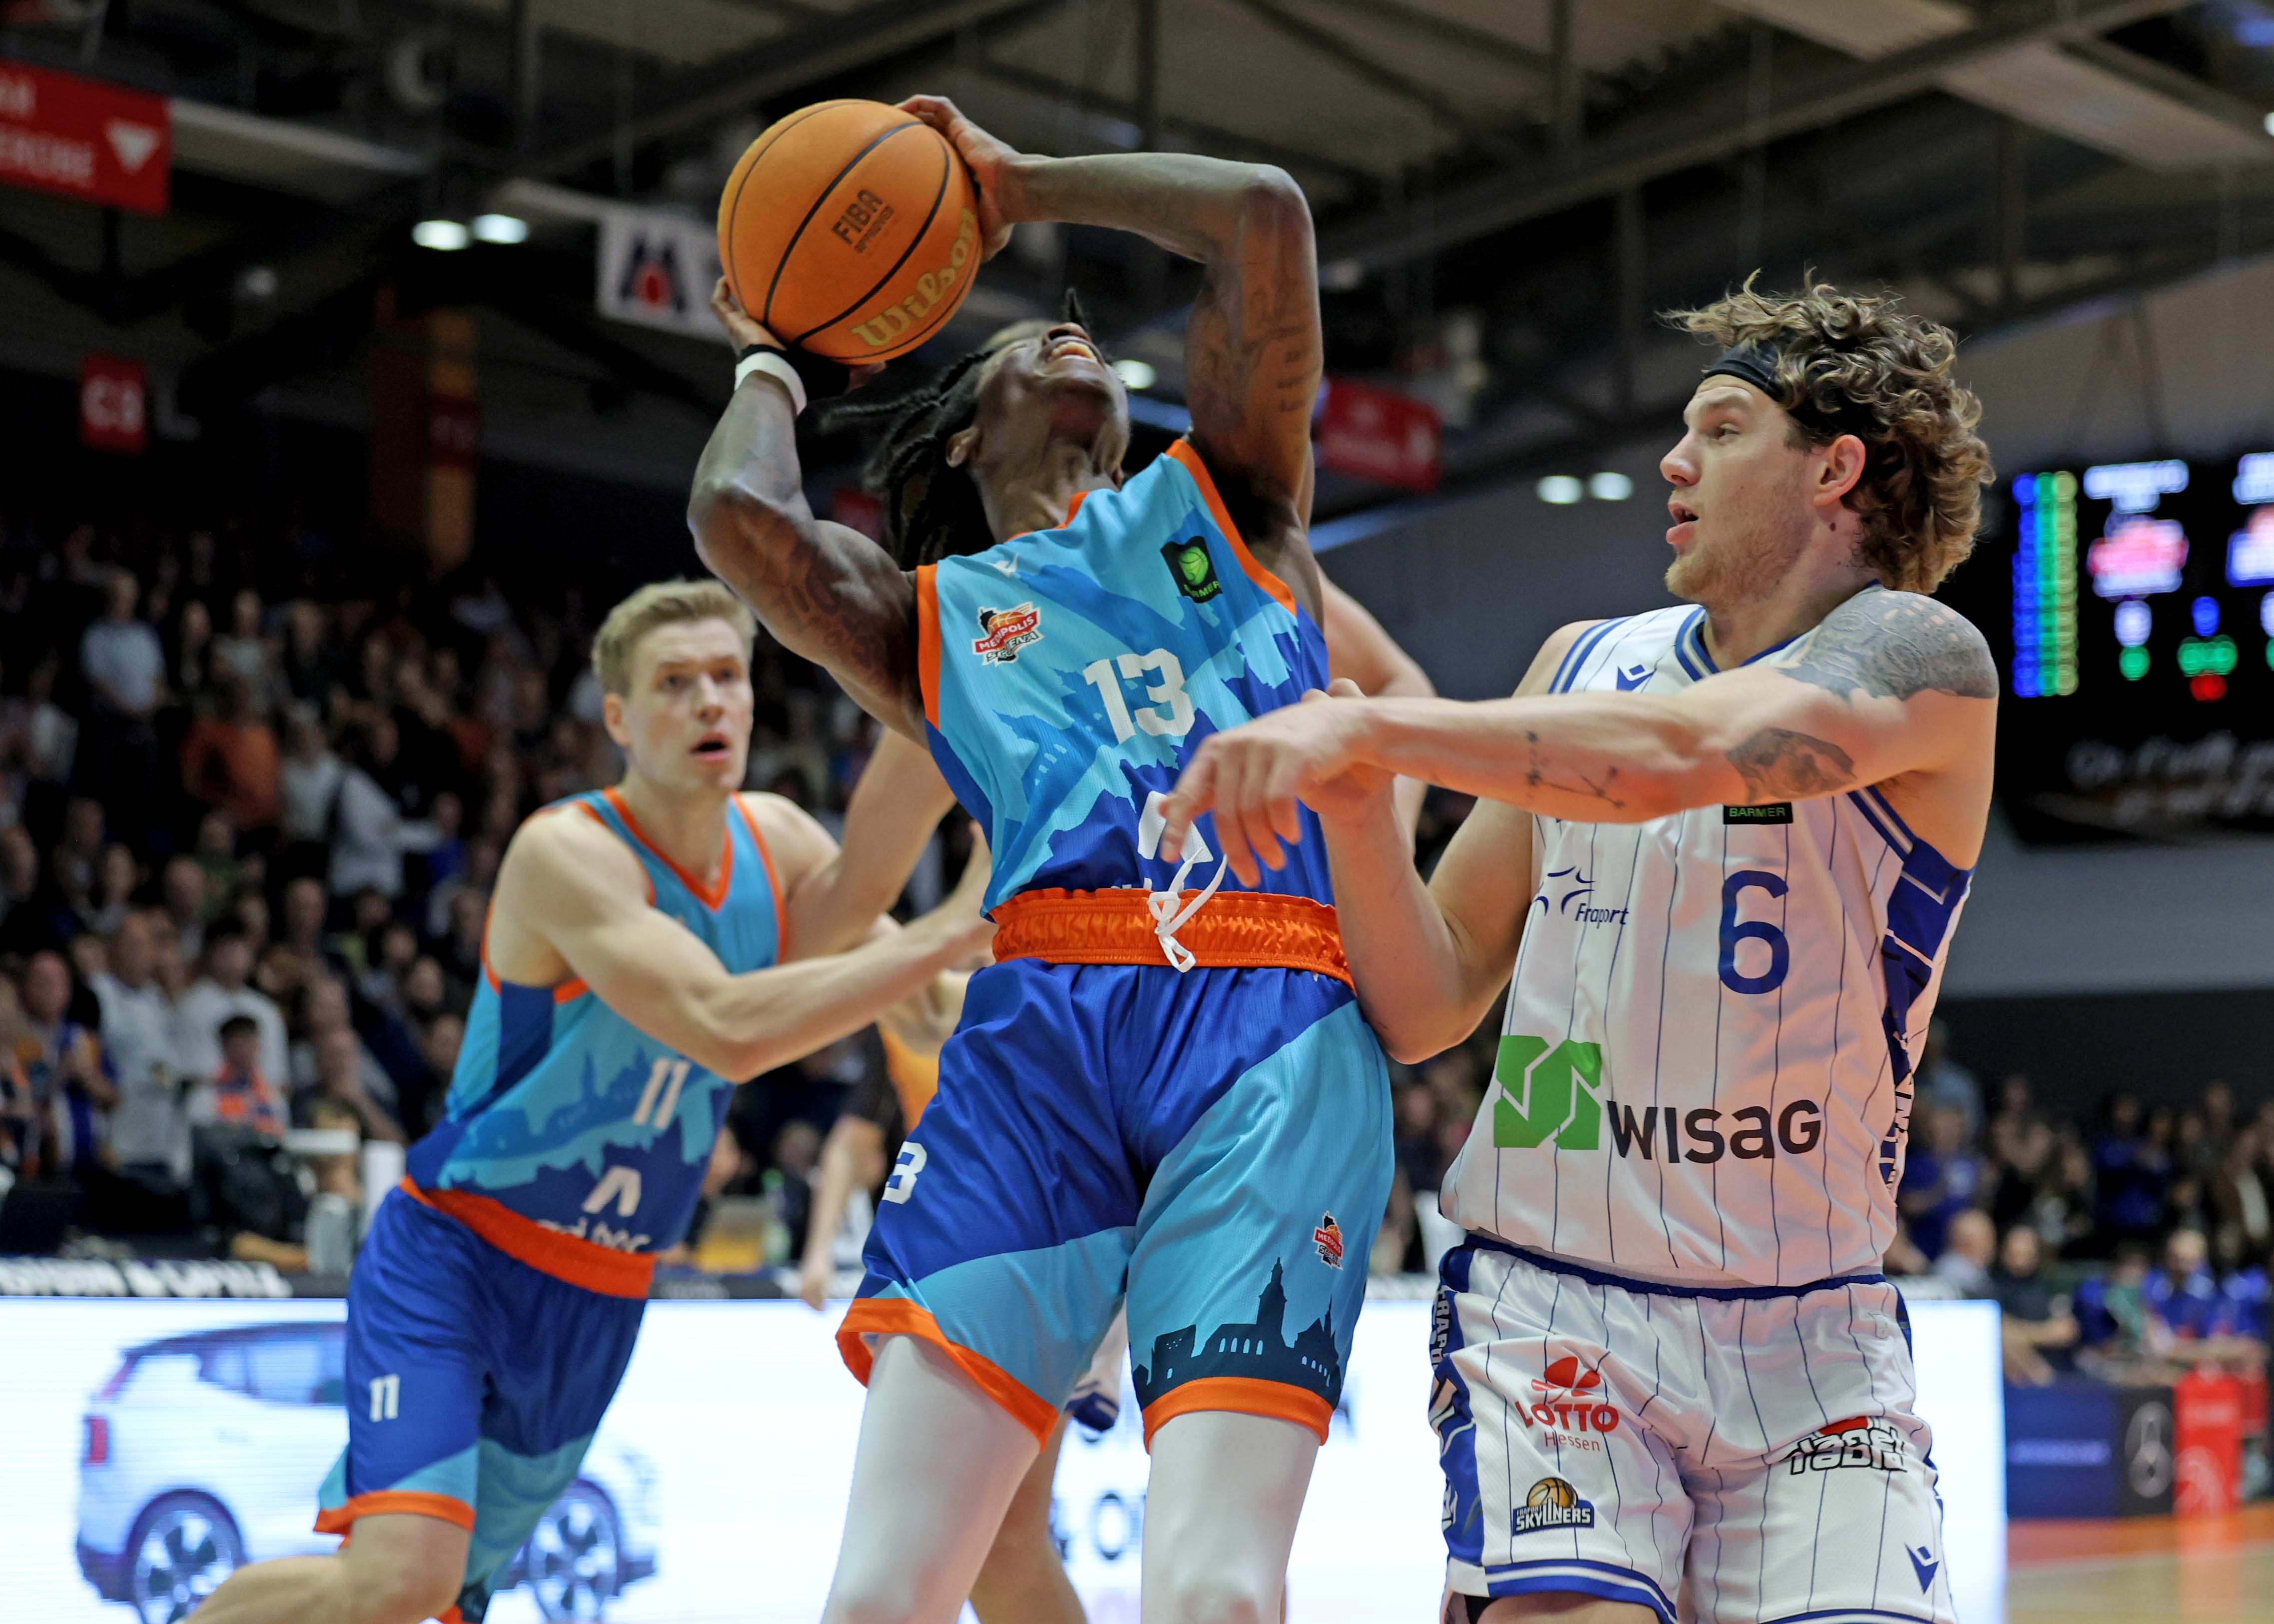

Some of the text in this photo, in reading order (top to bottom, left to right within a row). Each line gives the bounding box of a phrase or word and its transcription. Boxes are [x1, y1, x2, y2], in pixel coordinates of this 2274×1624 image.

[831, 189, 883, 245] FIBA
[850, 205, 976, 346] Wilson
[1082, 648, 1196, 744] 13
[1728, 807, 1786, 817] BARMER
[1575, 902, 1629, 929] Fraport
[1718, 870, 1789, 994] 6
[633, 1056, 691, 1131] 11
[369, 1374, 400, 1423] 11
[1515, 1401, 1619, 1433] LOTTO
[1544, 1431, 1600, 1452] Hessen
[1516, 1498, 1591, 1532] SKYLINERS
